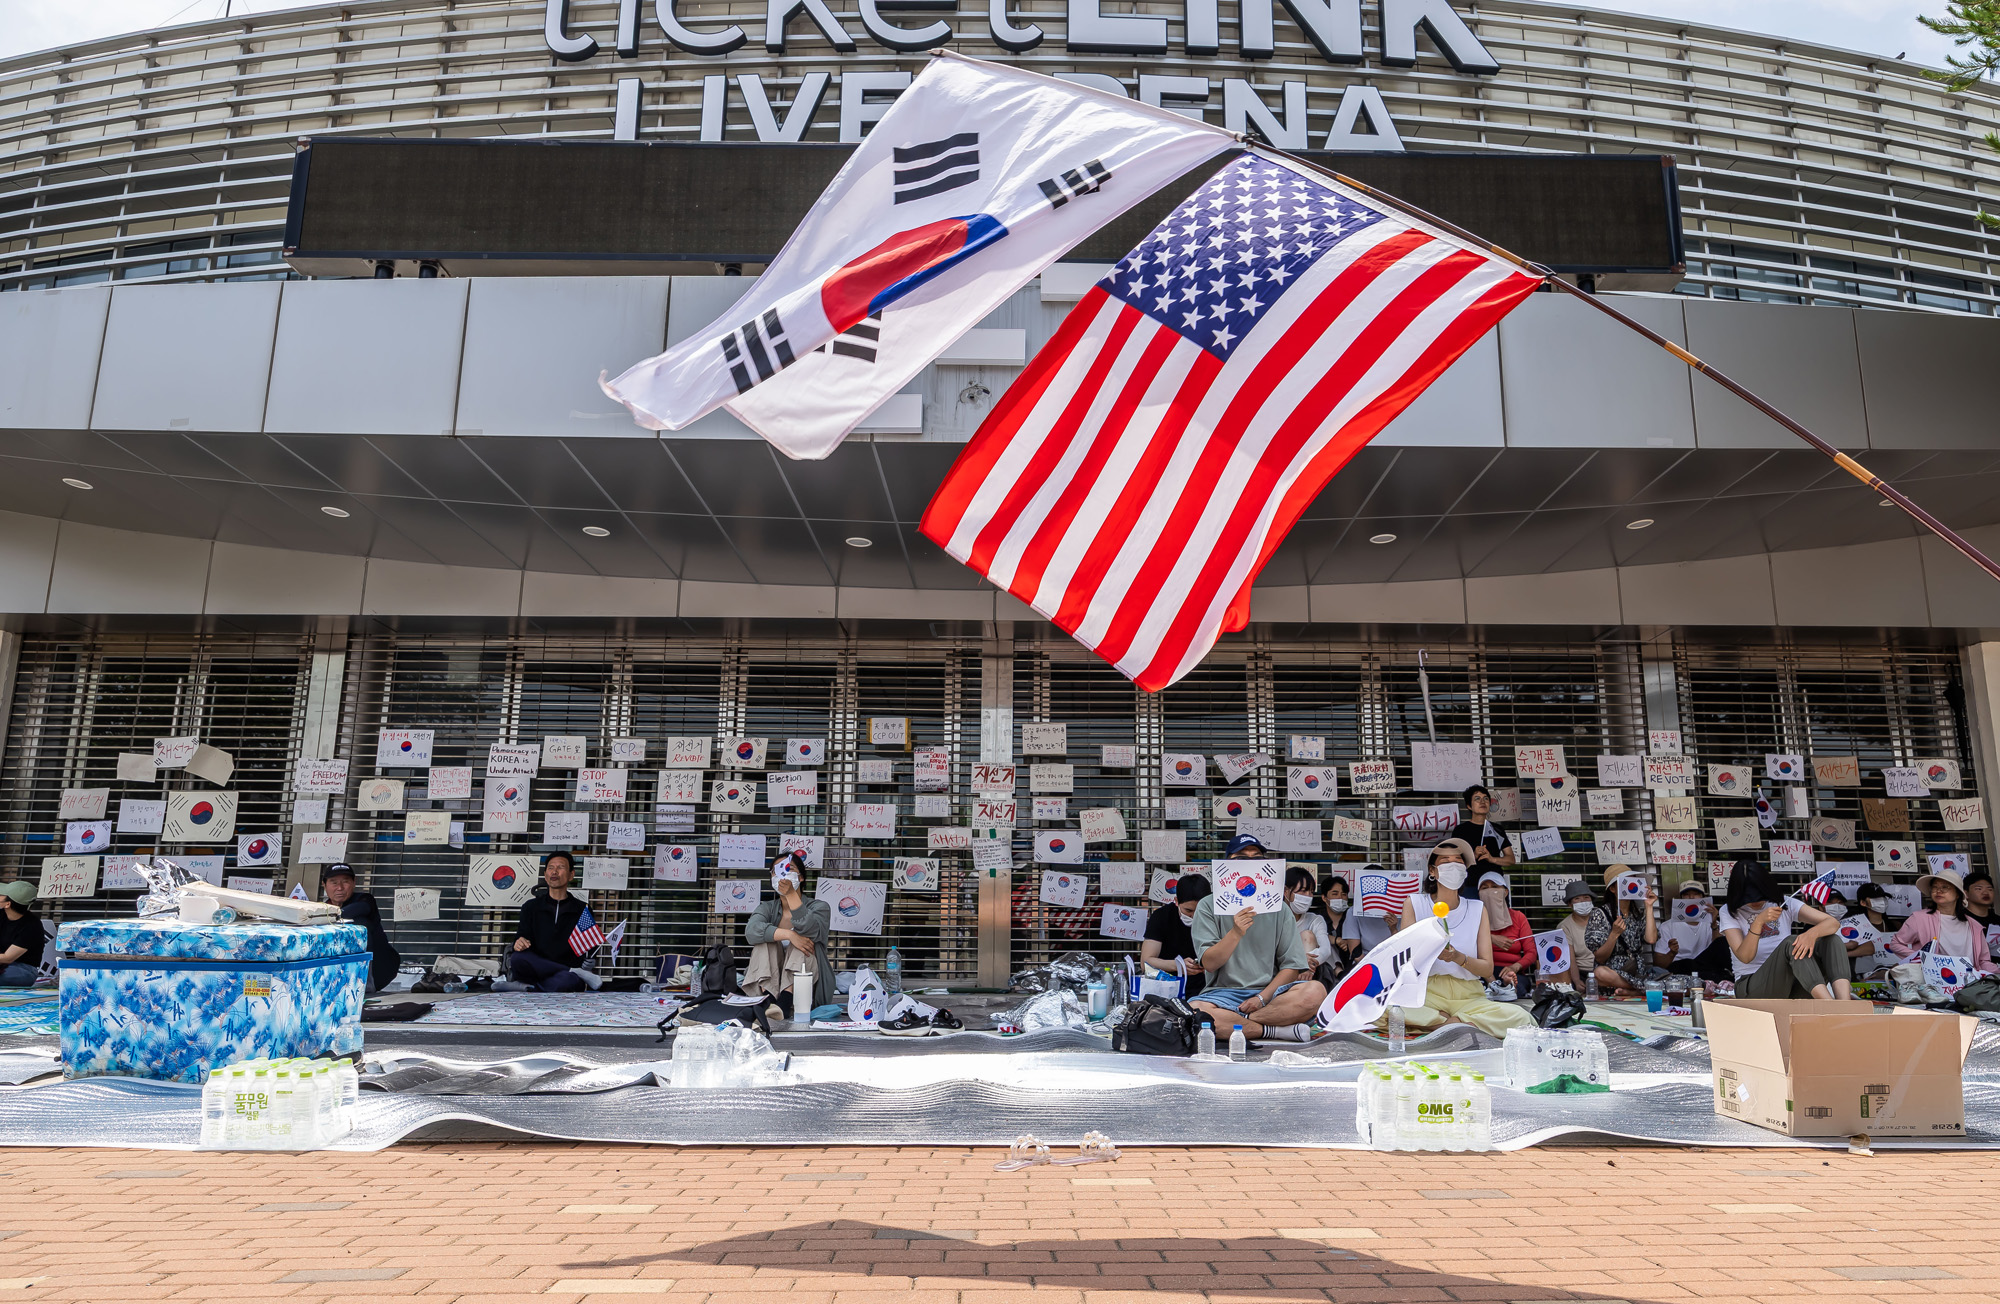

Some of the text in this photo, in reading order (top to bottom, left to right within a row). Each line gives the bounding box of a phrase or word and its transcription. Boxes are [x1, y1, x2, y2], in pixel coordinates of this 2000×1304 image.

[381, 732, 432, 742] 부정선거 재선거
[873, 731, 905, 740] CCP OUT
[1650, 732, 1677, 743] 선관위
[158, 742, 195, 759] 재선거
[492, 745, 530, 755] Democracy
[548, 745, 572, 754] GATE
[613, 742, 636, 757] CCP
[672, 738, 704, 754] 재선거
[409, 752, 428, 760] 수개표
[490, 754, 530, 764] KOREA is
[1298, 751, 1320, 759] 수개표
[1517, 748, 1556, 765] 수개표
[323, 761, 346, 772] Fighting
[489, 767, 538, 775] Under Attack!
[1518, 760, 1560, 775] 재선거
[1604, 761, 1639, 777] 재선거
[1648, 764, 1684, 775] 재선거
[1816, 761, 1858, 780] 재선거
[312, 770, 347, 781] FREEDOM
[582, 770, 608, 781] STOP
[664, 773, 698, 784] 부정선거
[768, 774, 802, 783] Election
[973, 766, 1015, 785] 재선거
[1650, 774, 1692, 784] RE VOTE
[1887, 769, 1898, 778] Stop
[663, 783, 693, 791] 재선거
[786, 785, 816, 796] Fraud
[1888, 780, 1919, 795] 재선거
[594, 789, 624, 799] STEAL
[662, 791, 695, 800] 수개표
[1590, 793, 1617, 802] 재선거
[62, 794, 105, 814] 재선거
[858, 804, 883, 816] 재선거
[1541, 799, 1572, 813] 재선거
[977, 802, 1016, 823] 재선거
[1657, 802, 1693, 823] 재선거
[1865, 803, 1908, 824] Reelection
[1942, 803, 1982, 823] 재선거
[549, 820, 583, 833] 재선거
[849, 819, 866, 832] Stop
[1395, 810, 1459, 842] 재선거
[1878, 817, 1907, 829] 재선거
[611, 825, 642, 837] 재선거
[1240, 821, 1275, 838] 재선거
[305, 835, 346, 848] 재선거
[929, 833, 969, 848] 재선거
[1286, 828, 1315, 844] 재선거
[1525, 833, 1554, 845] 재선거
[1650, 833, 1694, 841] 부정선거 재선거
[784, 838, 814, 849] 재선거
[1601, 840, 1641, 856] 재선거
[1772, 844, 1813, 860] 재선거
[53, 859, 87, 872] Stop The
[656, 866, 693, 878] 재선거
[1218, 870, 1241, 888] 부정선거
[834, 883, 867, 902] 재선거
[1555, 1048, 1585, 1060] 삼다수
[234, 1093, 269, 1115] 풀무원
[1417, 1102, 1454, 1115] OMG
[246, 1110, 260, 1121] 샘물
[1931, 1122, 1955, 1132] 오리온
